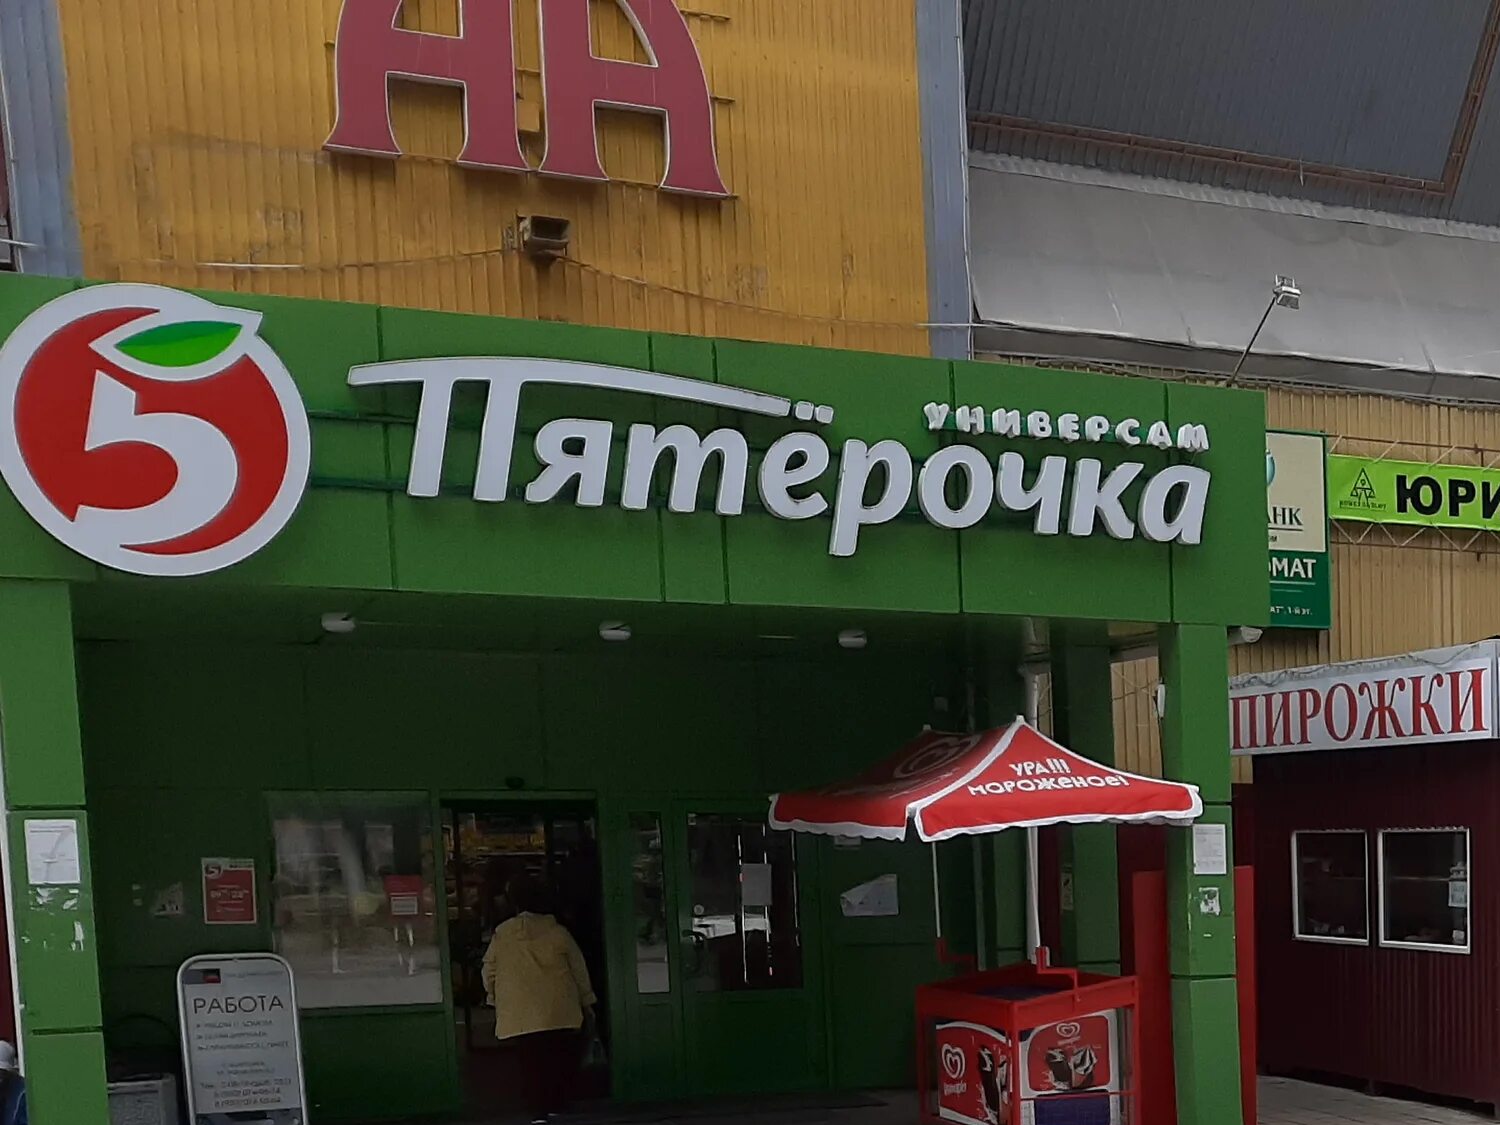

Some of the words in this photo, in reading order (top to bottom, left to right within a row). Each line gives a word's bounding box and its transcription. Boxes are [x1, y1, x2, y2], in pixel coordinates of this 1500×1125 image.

[924, 401, 1210, 450] УНИВЕРСАМ
[347, 355, 1210, 557] Пятёрочка
[1268, 557, 1317, 579] МАТ
[1231, 667, 1488, 749] ПИРОЖКИ
[1008, 758, 1072, 776] УРА!!!
[193, 995, 284, 1014] РАБОТА
